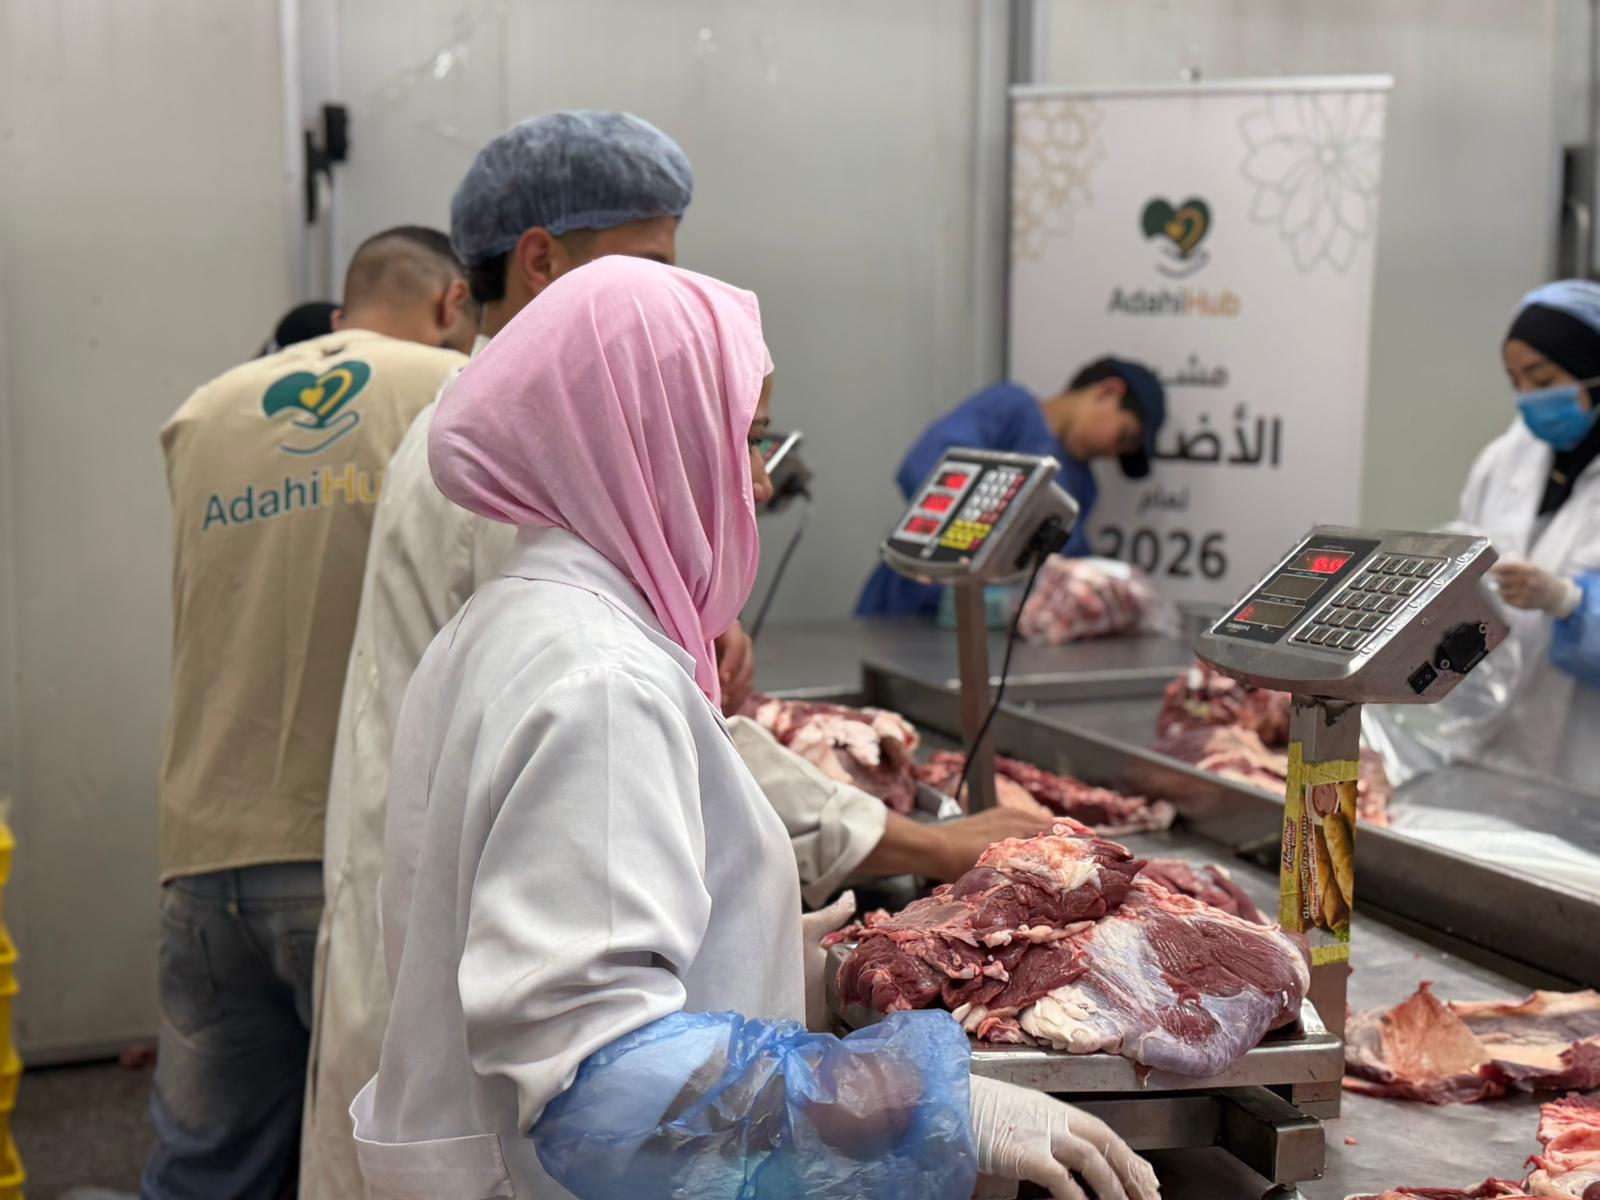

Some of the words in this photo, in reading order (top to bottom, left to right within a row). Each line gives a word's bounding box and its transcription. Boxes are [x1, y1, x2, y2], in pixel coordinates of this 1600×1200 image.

[1107, 286, 1242, 319] AdahiHub
[1152, 402, 1282, 467] الأض
[202, 462, 385, 531] AdahiHu
